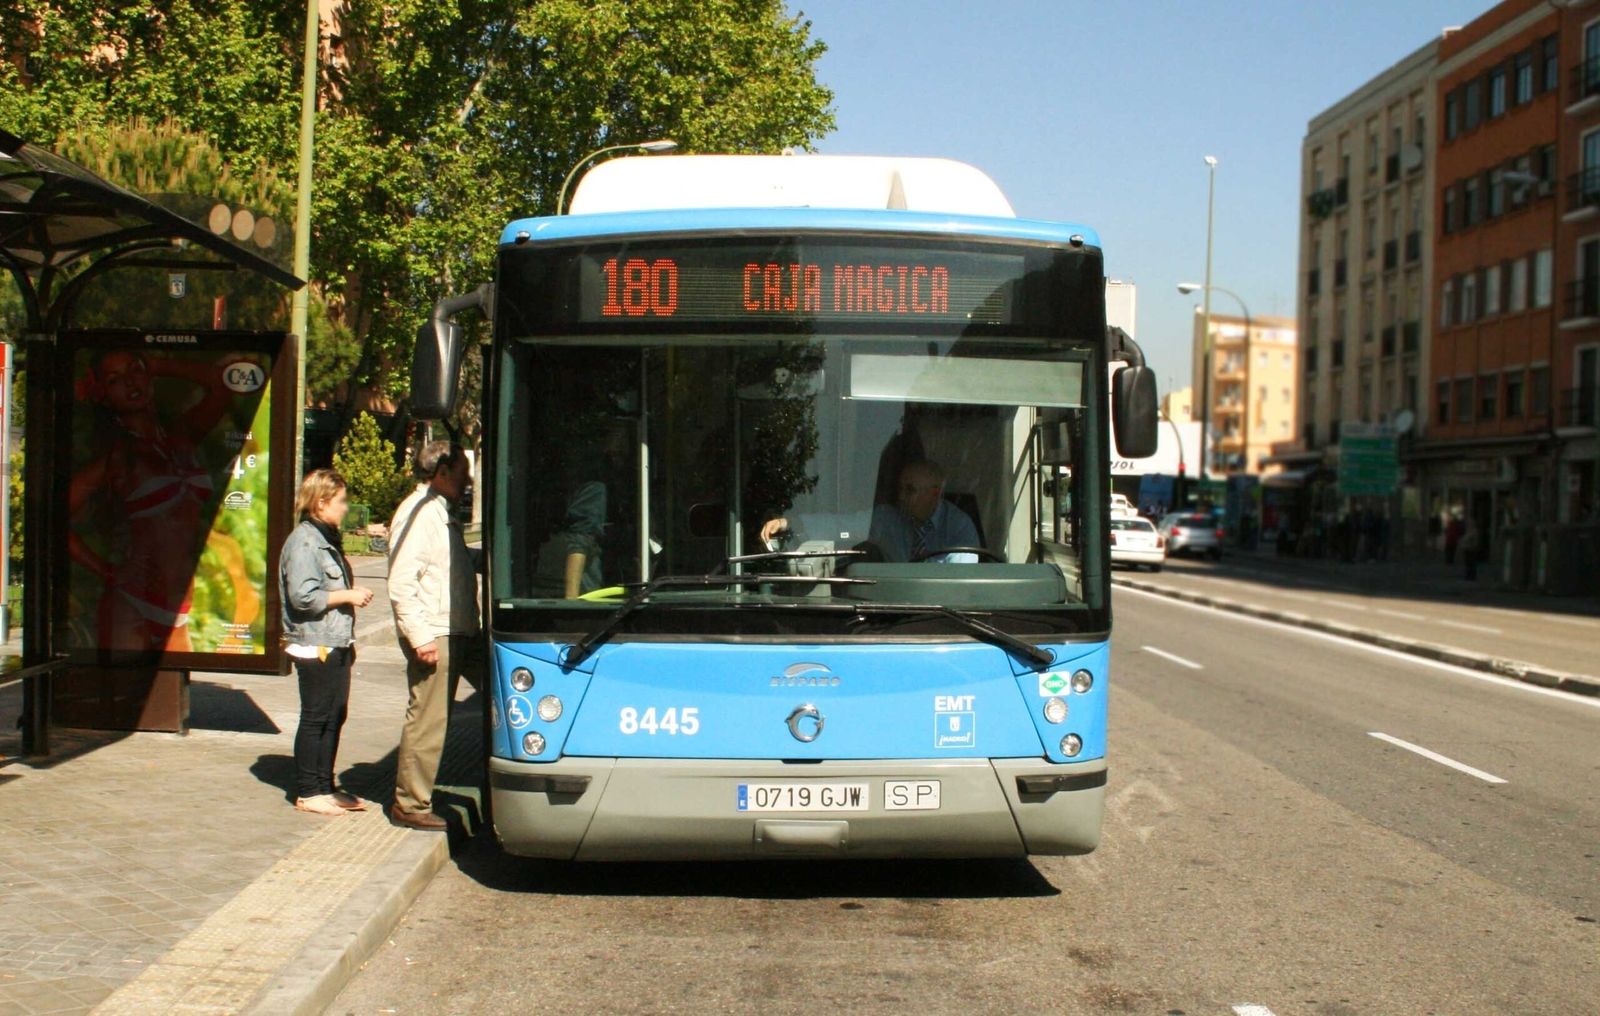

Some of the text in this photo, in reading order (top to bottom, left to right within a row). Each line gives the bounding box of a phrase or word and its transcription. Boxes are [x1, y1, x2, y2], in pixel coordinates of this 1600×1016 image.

[602, 258, 949, 316] 180 CAJA MAGICA
[156, 335, 197, 343] CEMUSA
[227, 368, 259, 386] C&A
[935, 695, 975, 711] EMT
[619, 706, 700, 736] 8445
[755, 787, 811, 808] 0719
[820, 787, 861, 807] GJW
